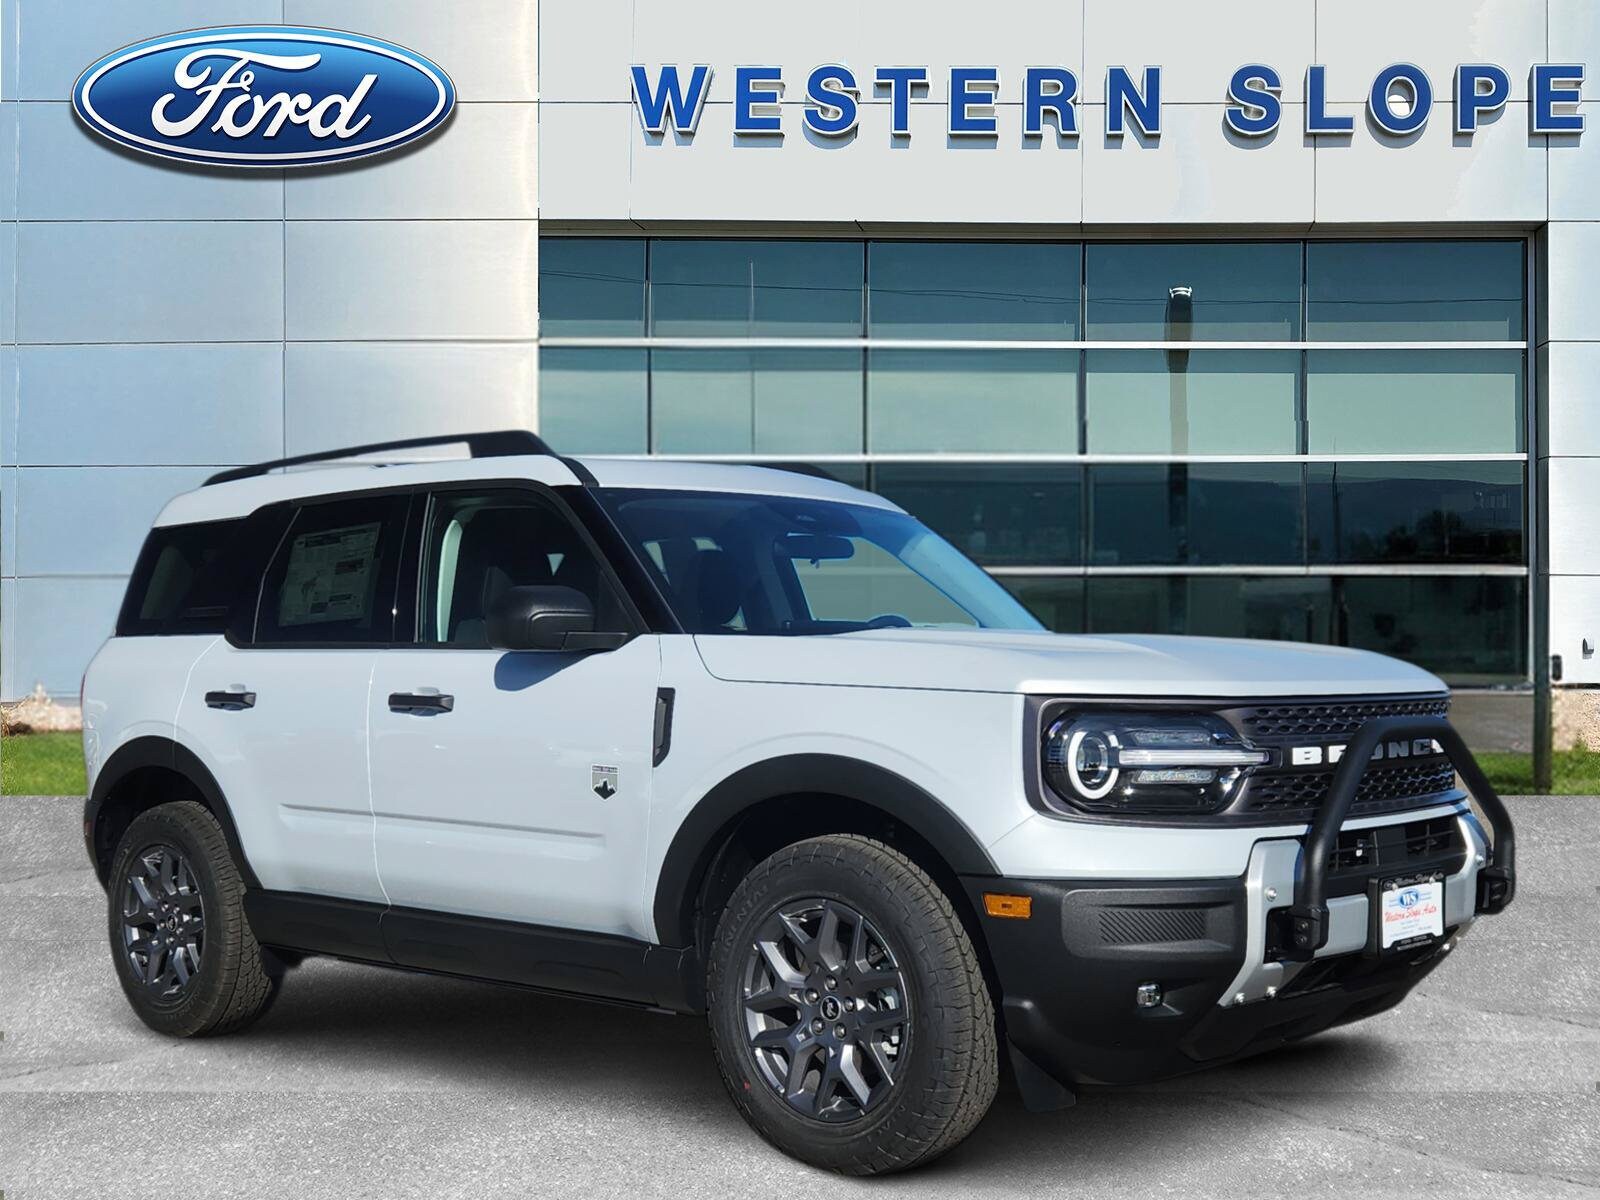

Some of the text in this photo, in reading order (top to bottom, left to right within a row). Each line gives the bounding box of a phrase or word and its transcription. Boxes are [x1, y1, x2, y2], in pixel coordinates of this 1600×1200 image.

[151, 48, 378, 139] Ford
[629, 63, 1587, 138] WESTERN SLOPE
